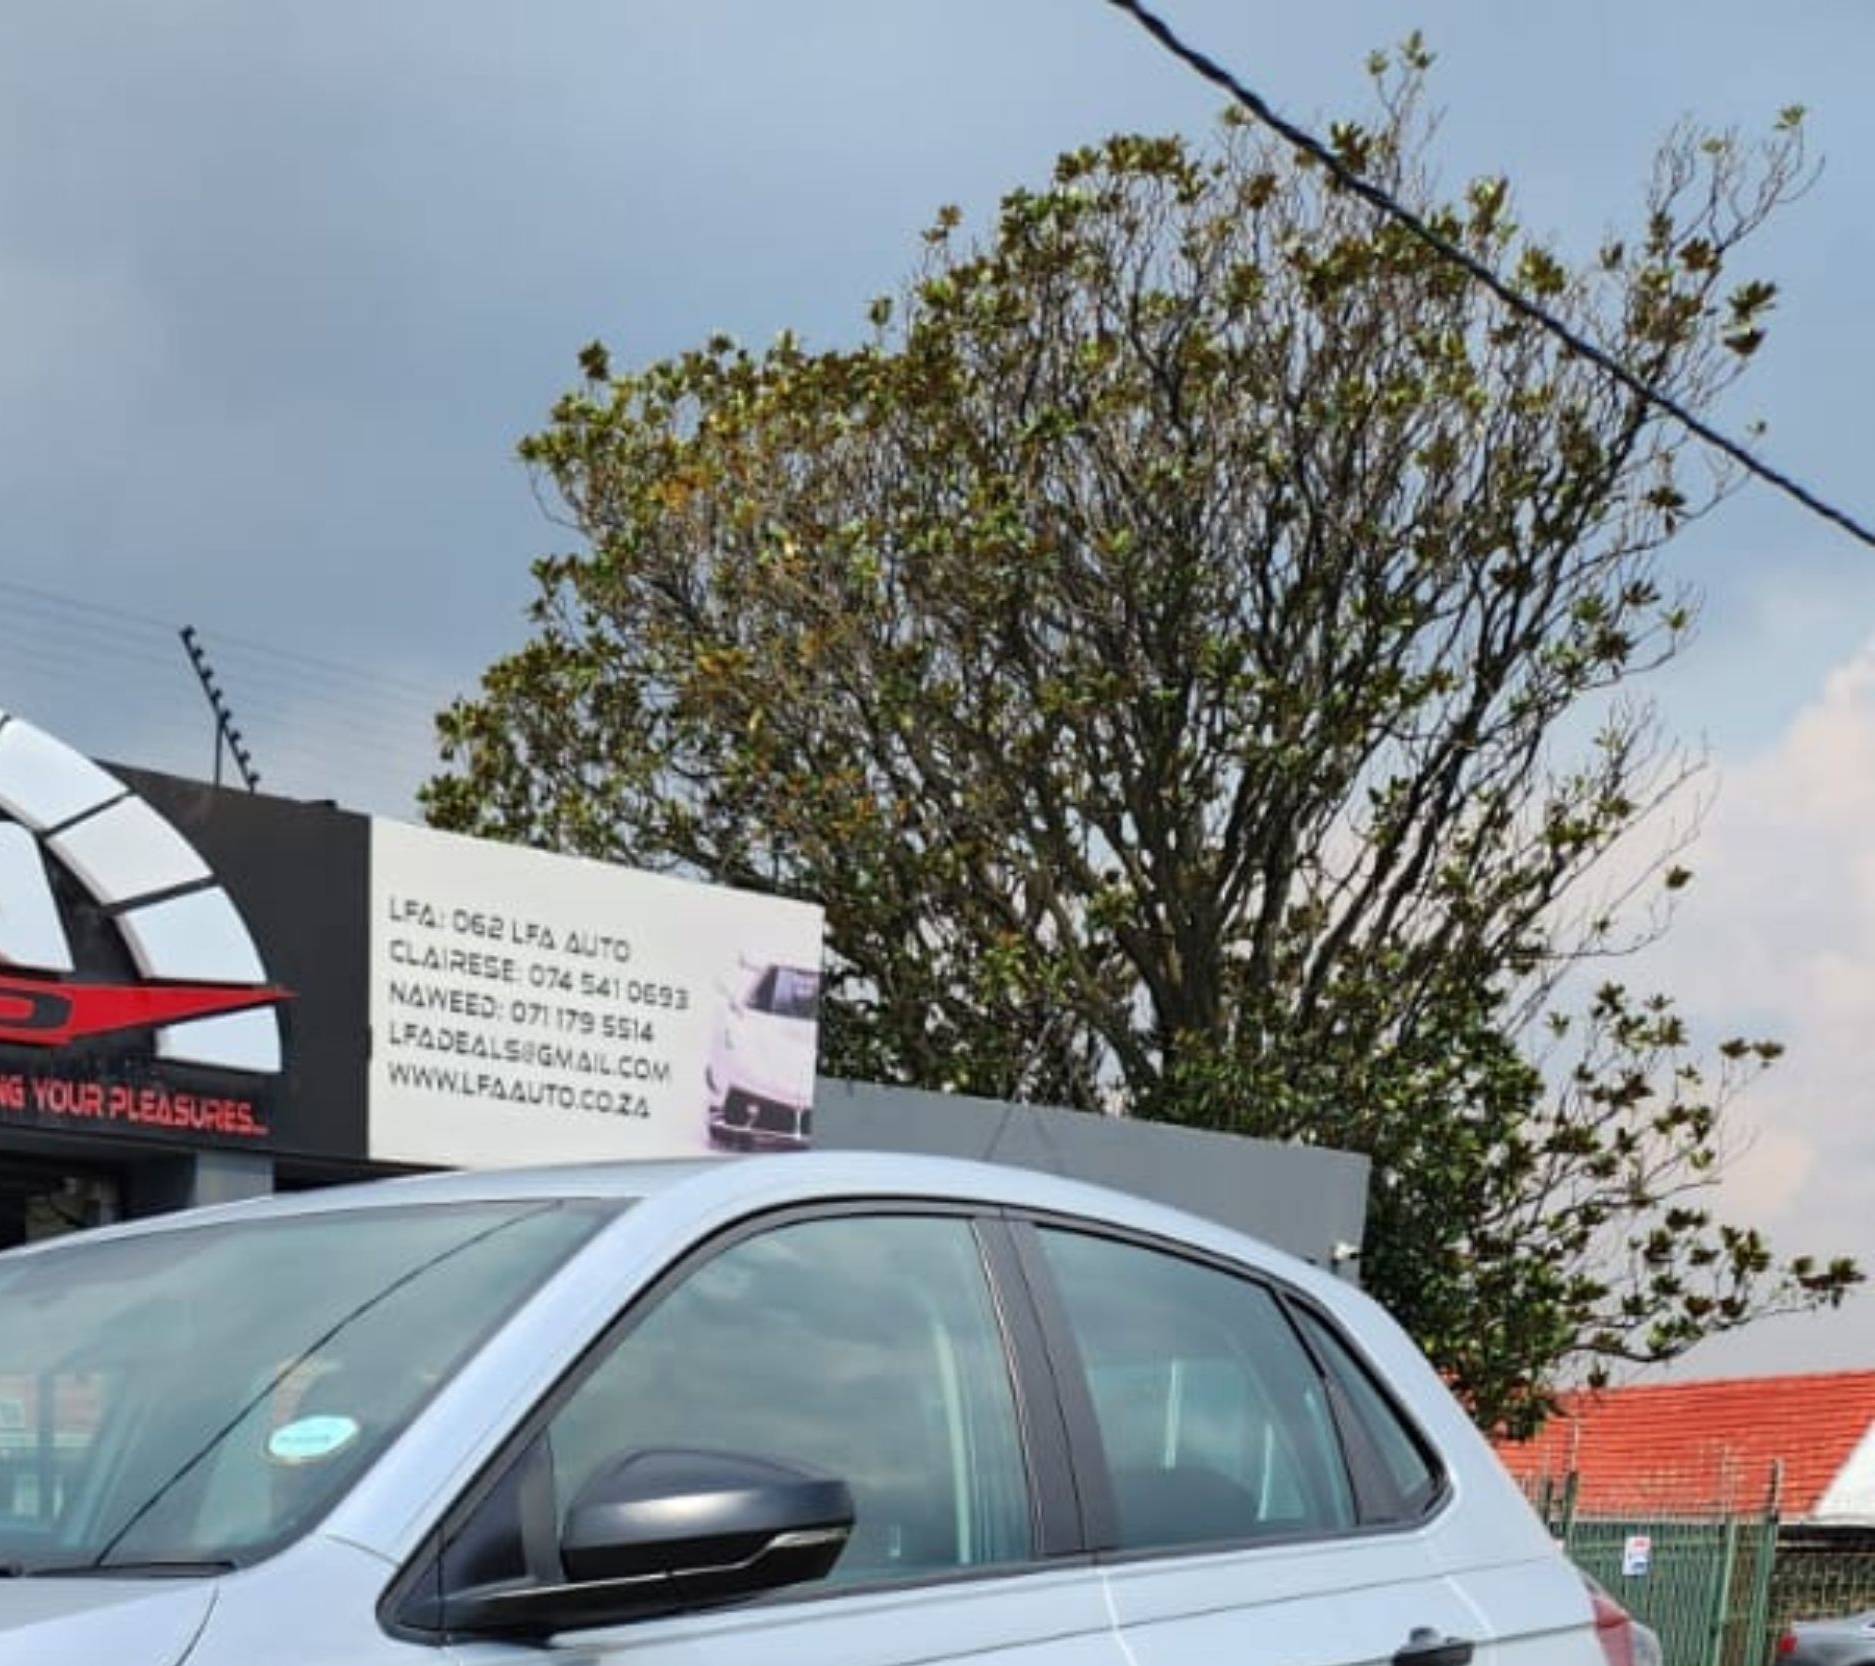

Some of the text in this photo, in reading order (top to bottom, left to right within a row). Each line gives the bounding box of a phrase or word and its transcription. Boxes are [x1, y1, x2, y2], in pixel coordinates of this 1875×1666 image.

[388, 897, 632, 964] LFA: 062 LFA AUTO
[389, 938, 690, 1011] CLAIRESE: 074 541 0693
[389, 980, 655, 1043] NAWEED: 071 179 5514
[389, 1021, 671, 1084] LFADEALS@GMAIL.COM
[34, 1078, 102, 1115] YOUR
[110, 1085, 268, 1136] PLEASURES...
[388, 1062, 651, 1120] WWW.LFAAUTO.CO.ZA
